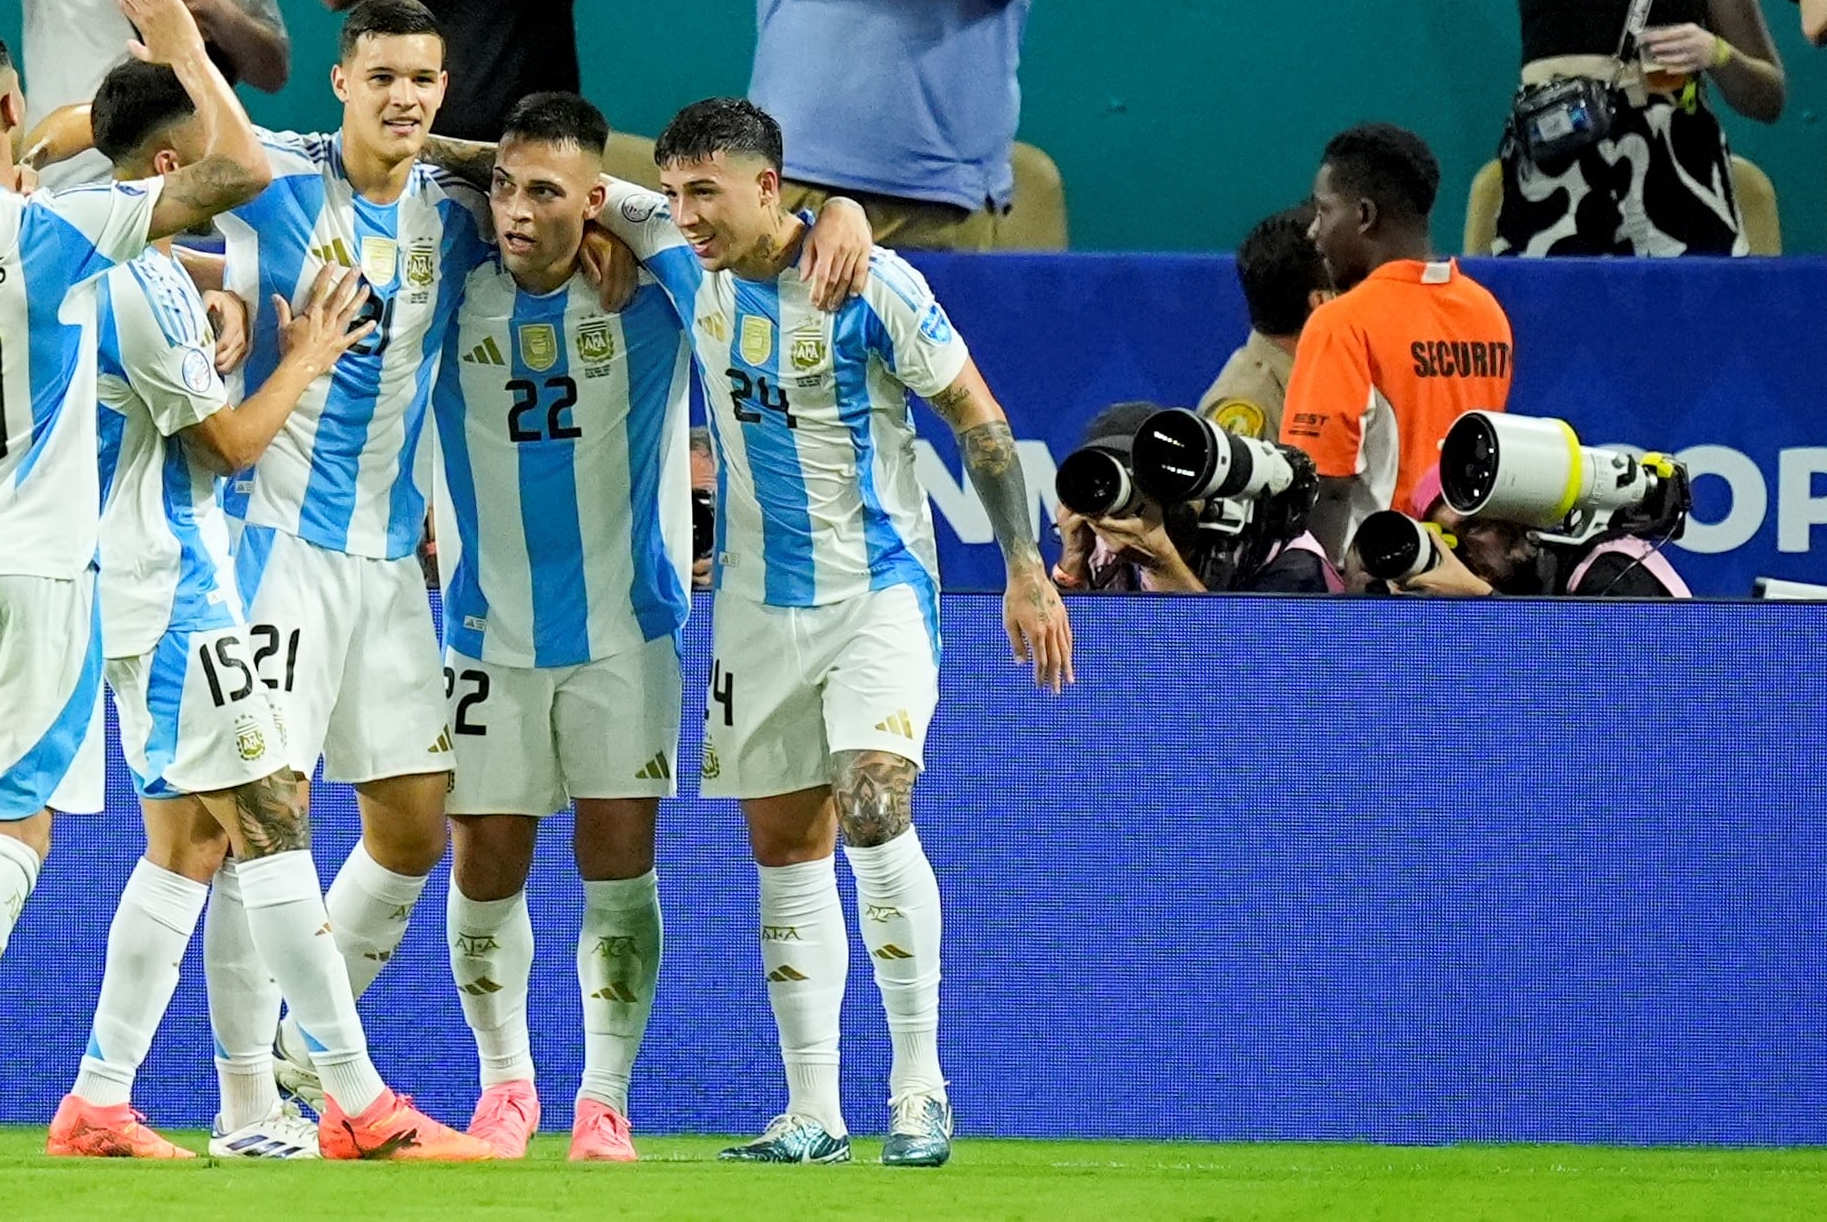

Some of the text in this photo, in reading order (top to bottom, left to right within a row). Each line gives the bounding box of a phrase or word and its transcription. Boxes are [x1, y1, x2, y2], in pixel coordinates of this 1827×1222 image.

[1410, 340, 1511, 379] SECURIT
[504, 376, 583, 443] 22
[725, 368, 798, 429] 24
[199, 635, 254, 708] 15
[250, 624, 301, 693] 21
[454, 931, 501, 959] AFA
